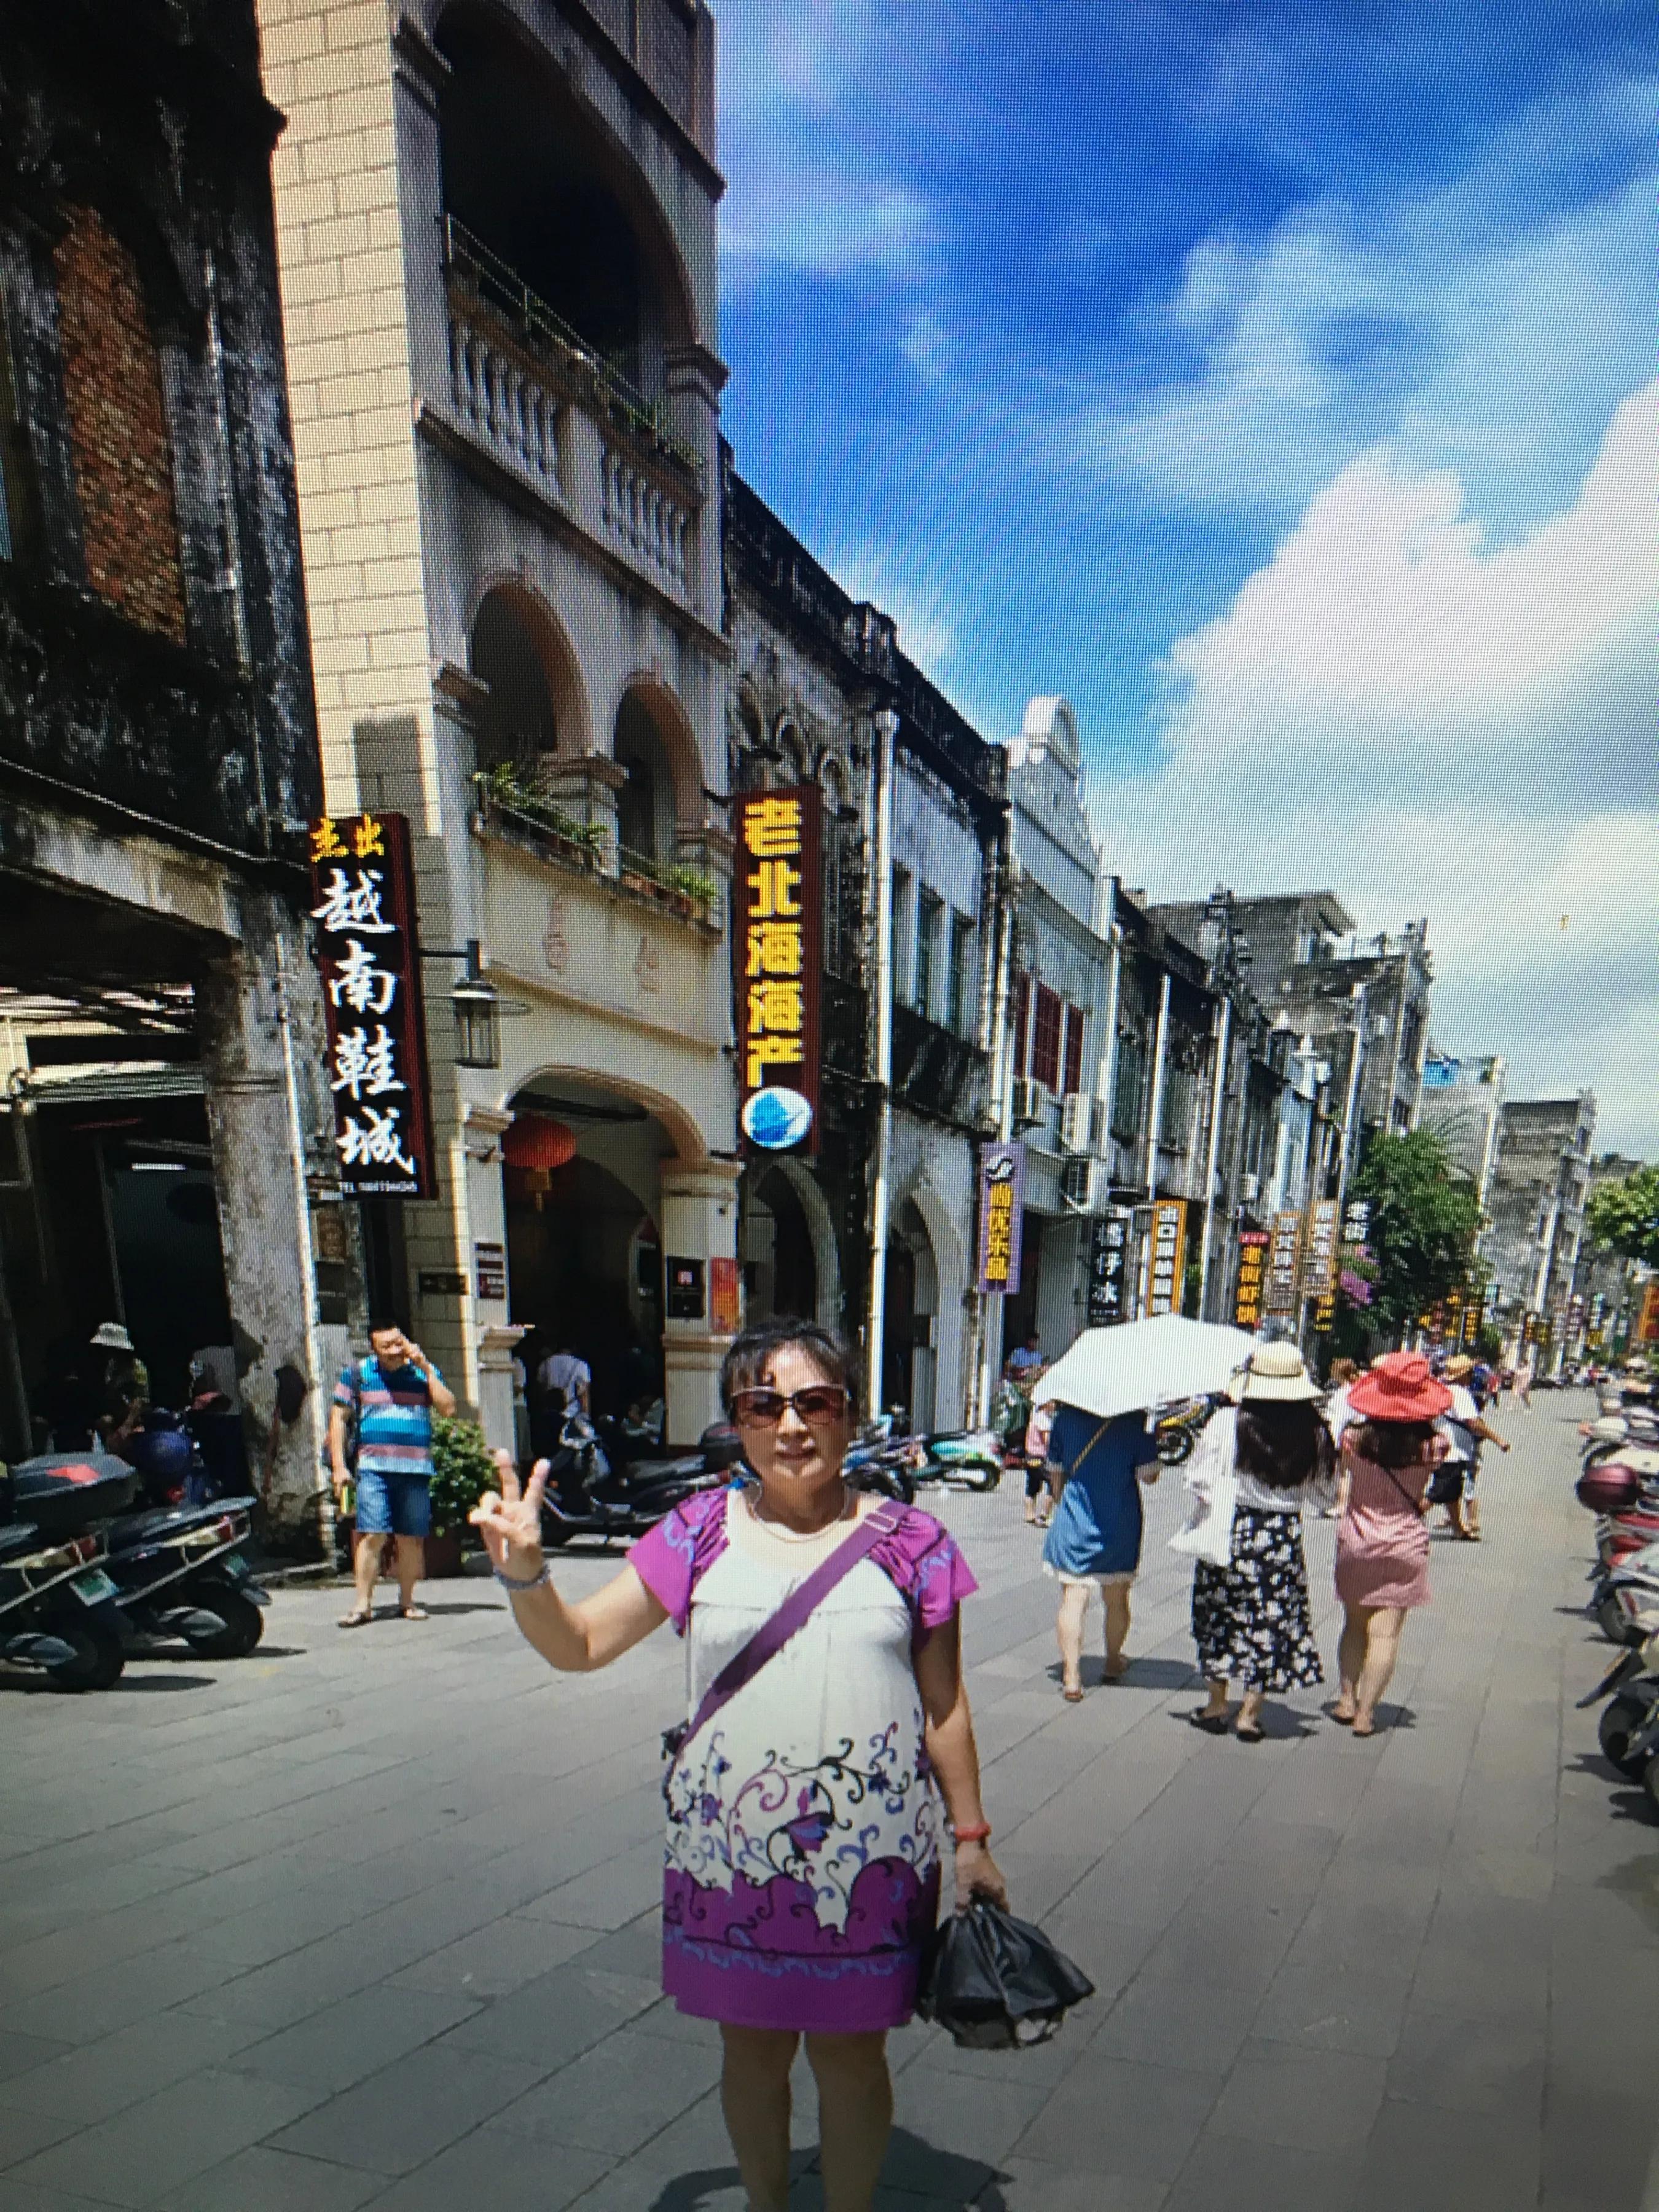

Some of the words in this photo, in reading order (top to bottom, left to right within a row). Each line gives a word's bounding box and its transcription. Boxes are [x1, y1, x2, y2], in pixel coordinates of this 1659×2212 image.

[310, 868, 416, 1174] 越南鞋城
[743, 798, 804, 1087] 老北海海产
